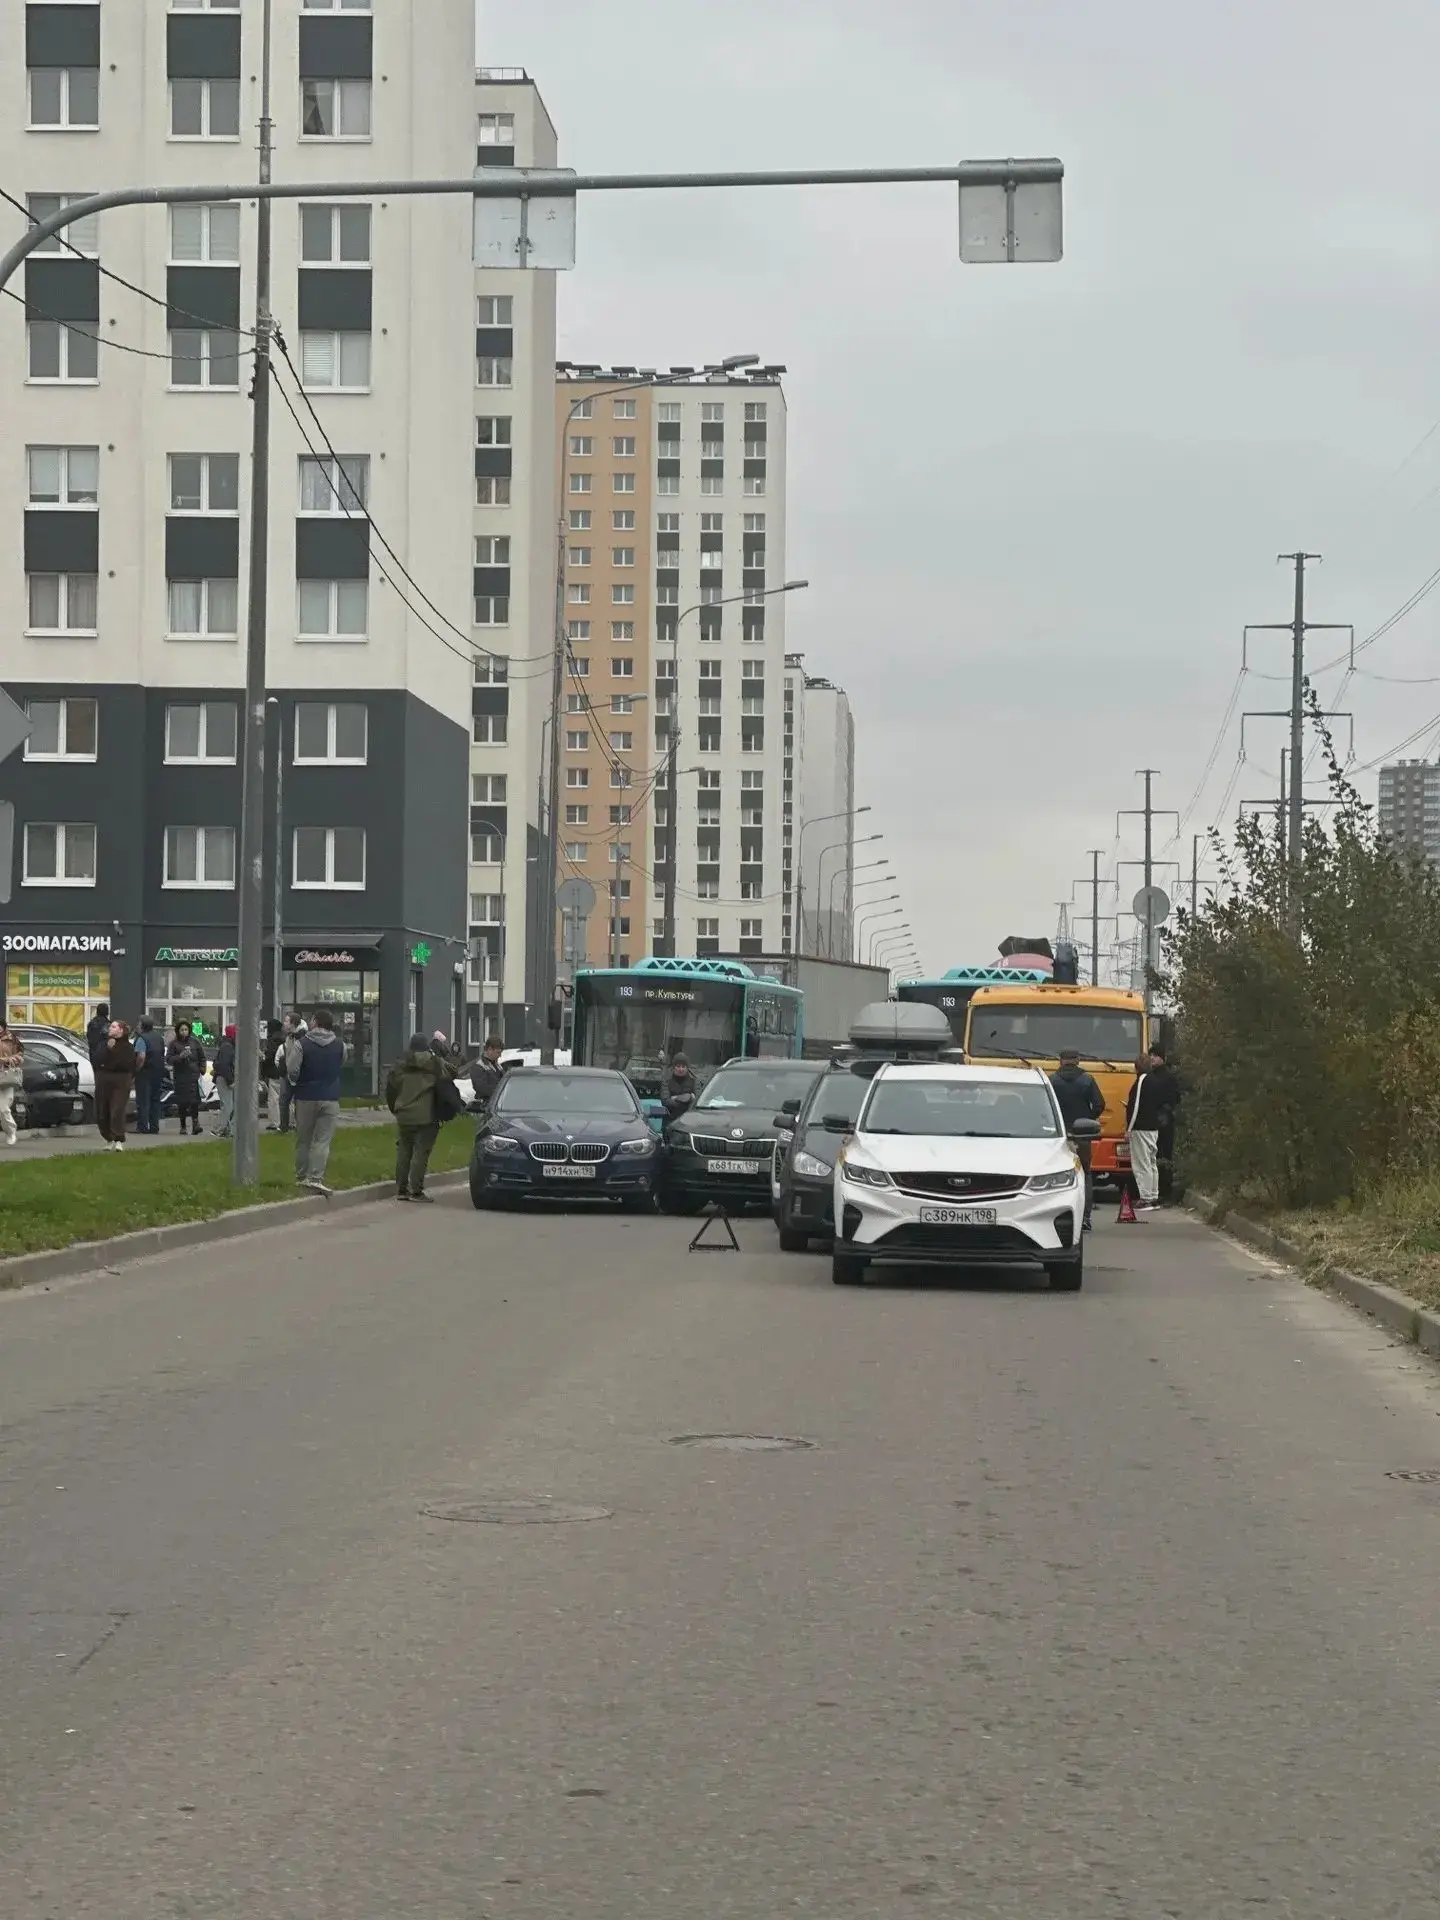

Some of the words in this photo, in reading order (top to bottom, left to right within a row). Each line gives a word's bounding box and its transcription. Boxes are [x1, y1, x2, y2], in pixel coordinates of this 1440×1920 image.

[2, 935, 111, 951] ЗООМАГАЗИН
[619, 986, 633, 996] 193
[942, 997, 955, 1007] 193
[924, 1209, 972, 1223] С389НК
